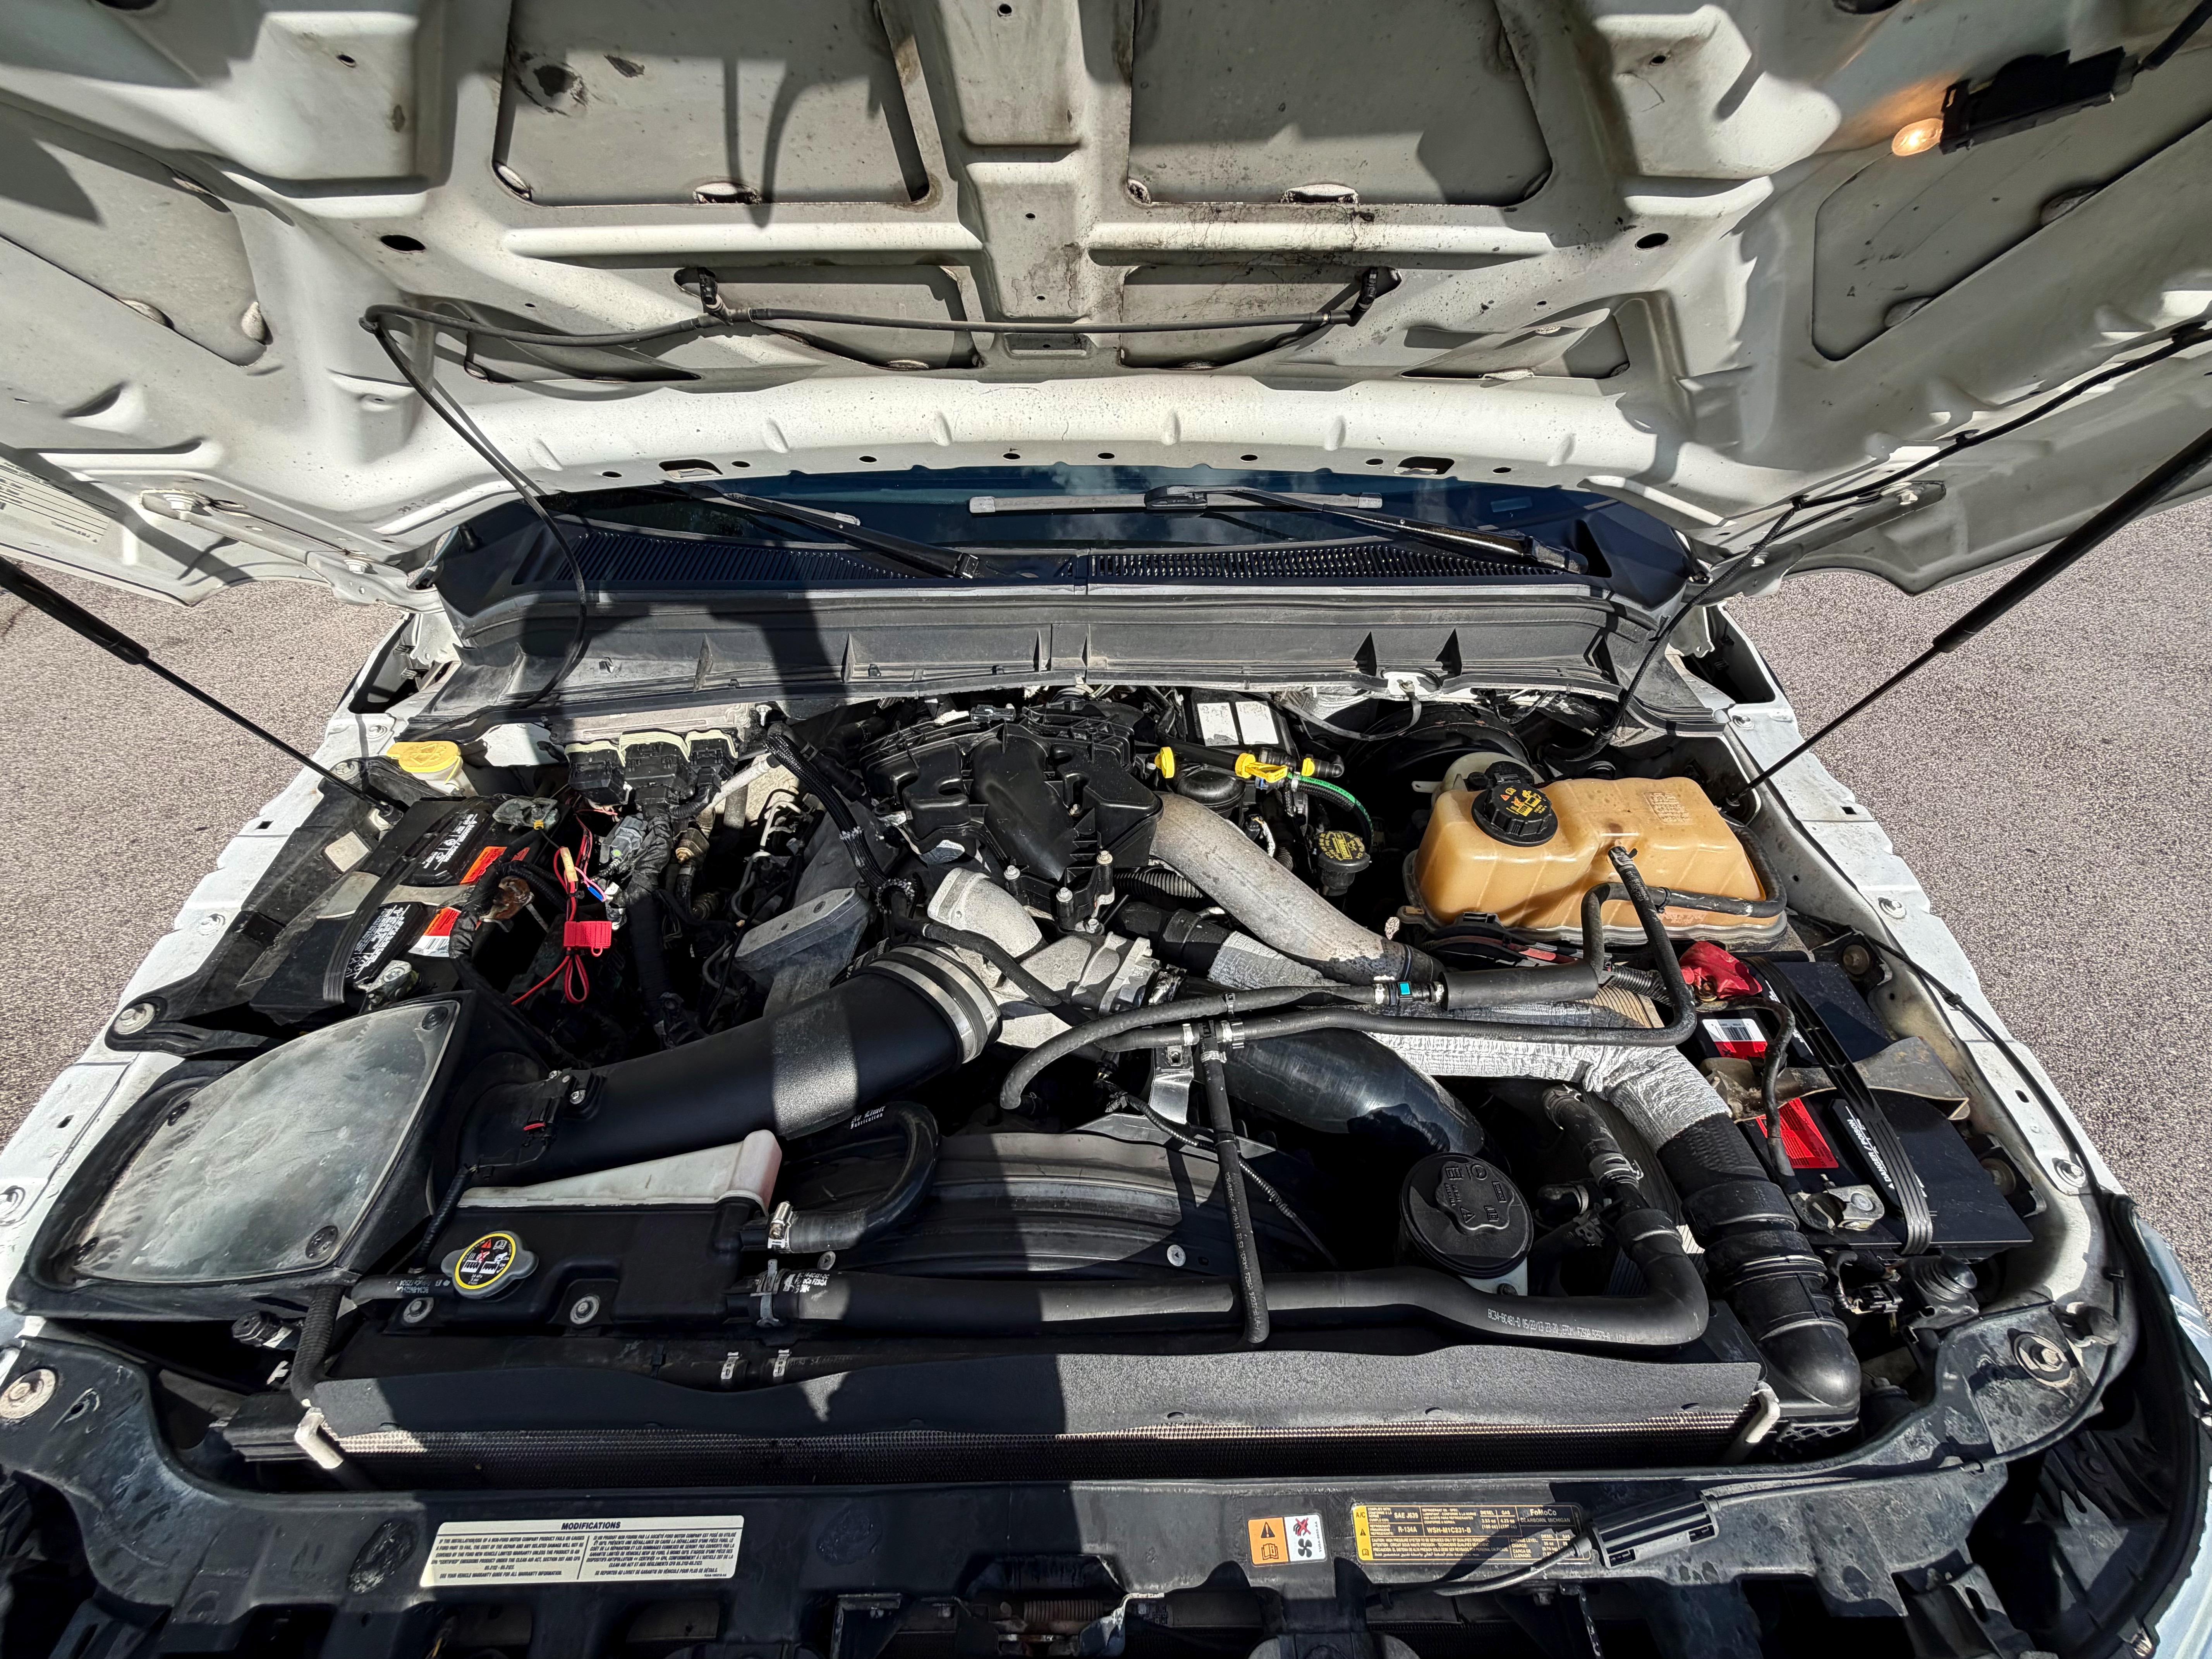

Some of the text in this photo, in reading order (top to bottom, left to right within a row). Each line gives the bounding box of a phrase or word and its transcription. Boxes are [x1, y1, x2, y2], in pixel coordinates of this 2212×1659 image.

[864, 1106, 885, 1118] Limit
[850, 1113, 883, 1129] Fabrication
[1847, 1119, 1868, 1145] POISON
[1868, 1152, 1892, 1182] DANGER
[561, 1522, 621, 1530] MODIFICATIONS
